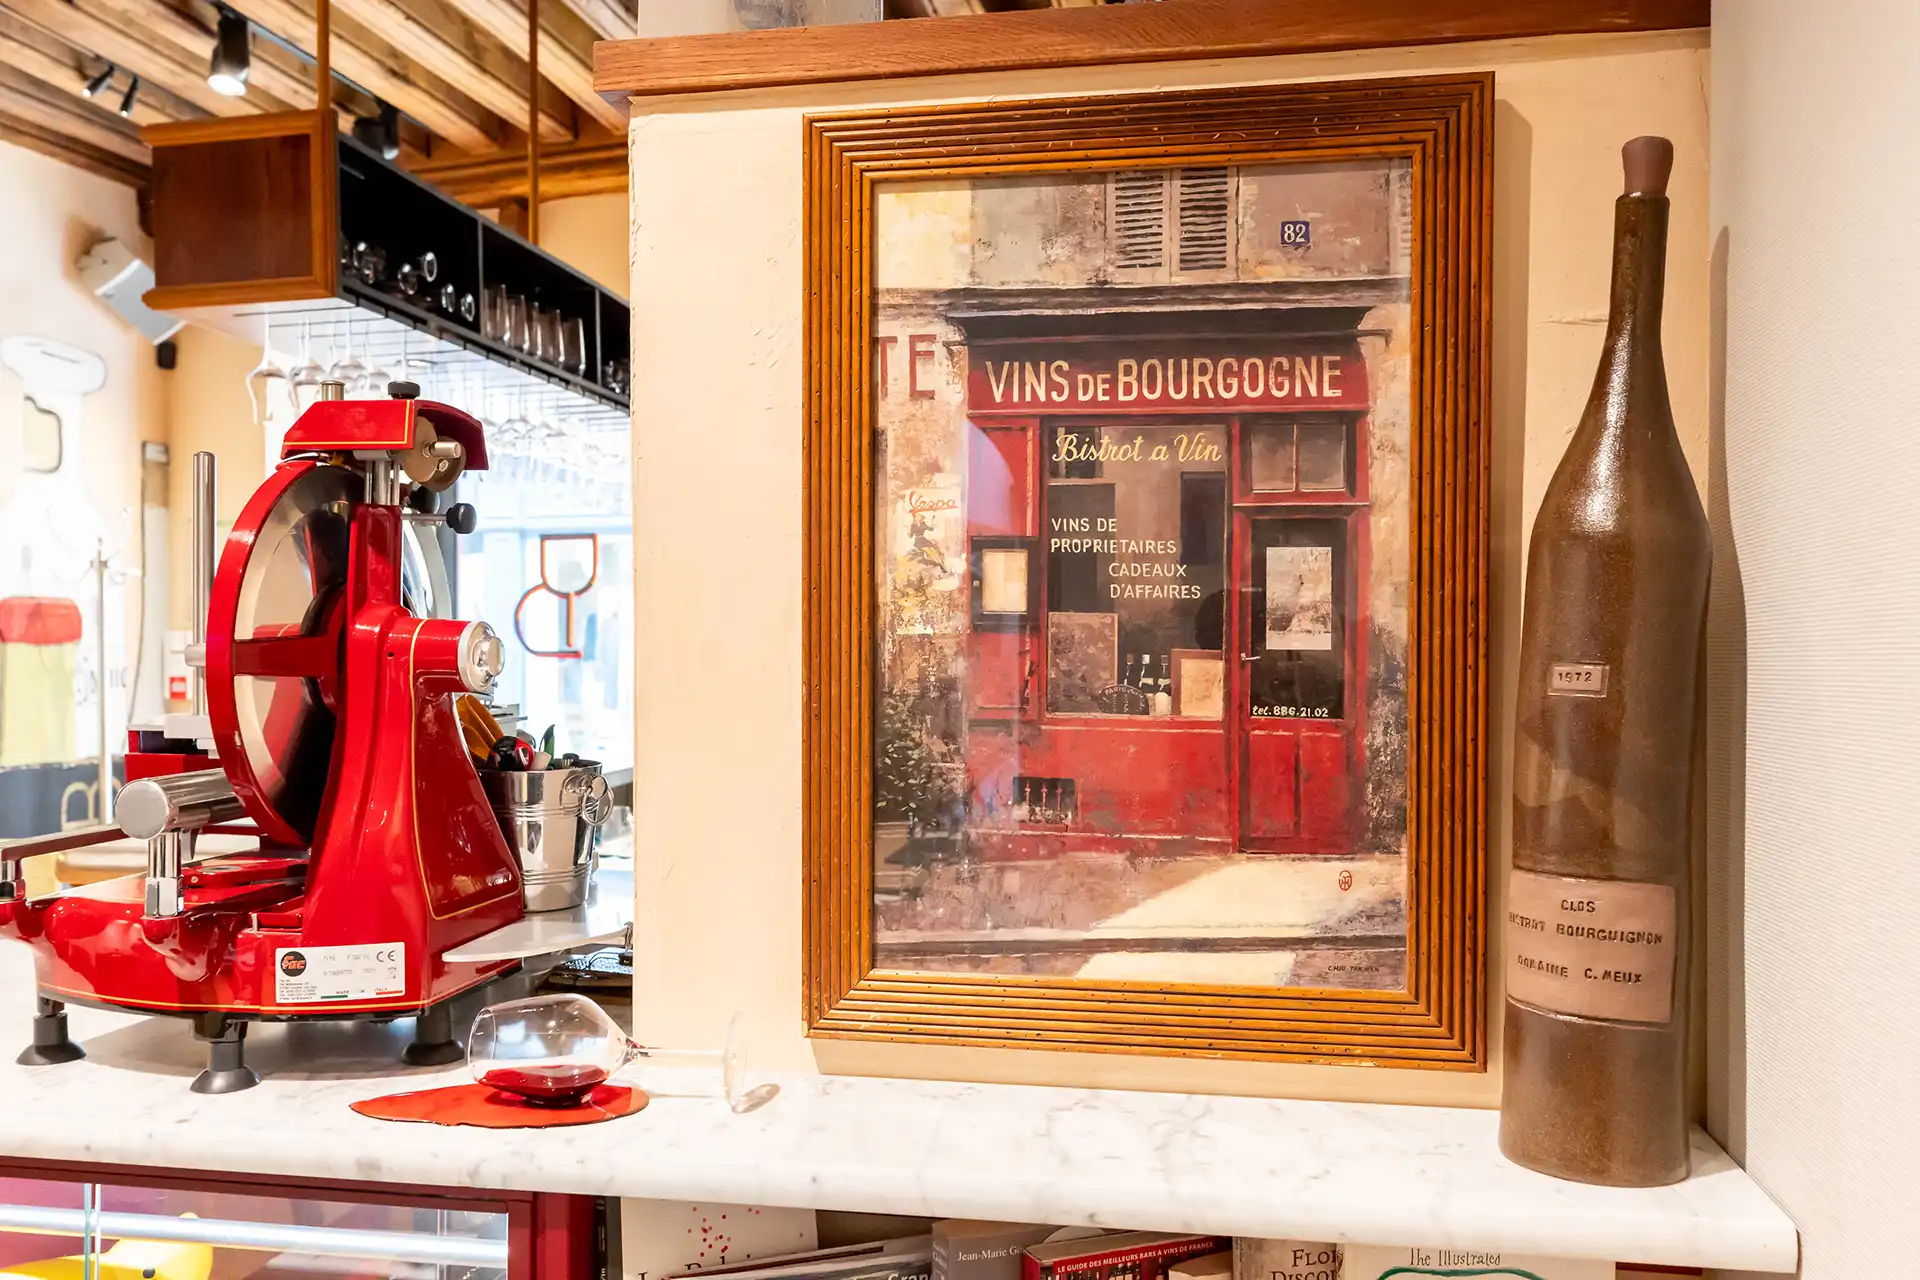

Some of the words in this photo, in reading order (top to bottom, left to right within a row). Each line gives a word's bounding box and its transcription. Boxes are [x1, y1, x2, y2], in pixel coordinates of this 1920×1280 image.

[1284, 223, 1306, 243] 82
[985, 359, 1070, 402] VINS
[1077, 373, 1111, 402] DE
[1118, 355, 1342, 401] BOURGOGNE
[1052, 432, 1144, 462] Bistrot
[1148, 444, 1169, 462] a
[1174, 432, 1222, 462] Vin
[1051, 517, 1090, 532] VINS
[1097, 517, 1117, 532] DE
[1050, 538, 1177, 554] PROPRIETAIRES
[1108, 562, 1187, 577] CADEAUX
[1109, 583, 1201, 599] D'AFFAIRES
[1558, 671, 1593, 684] 1972
[1560, 899, 1596, 913] CLOS
[1556, 923, 1664, 945] BOURGUIGNON
[957, 1248, 1007, 1262] Jean-Marie
[1067, 1262, 1088, 1271] GUIDE
[1089, 1259, 1102, 1268] DES
[1103, 1254, 1139, 1266] MEILLEURS
[1139, 1251, 1157, 1260] BARS
[1163, 1246, 1179, 1255] VINS
[1189, 1242, 1214, 1250] FRANCE
[1408, 1248, 1431, 1267] The
